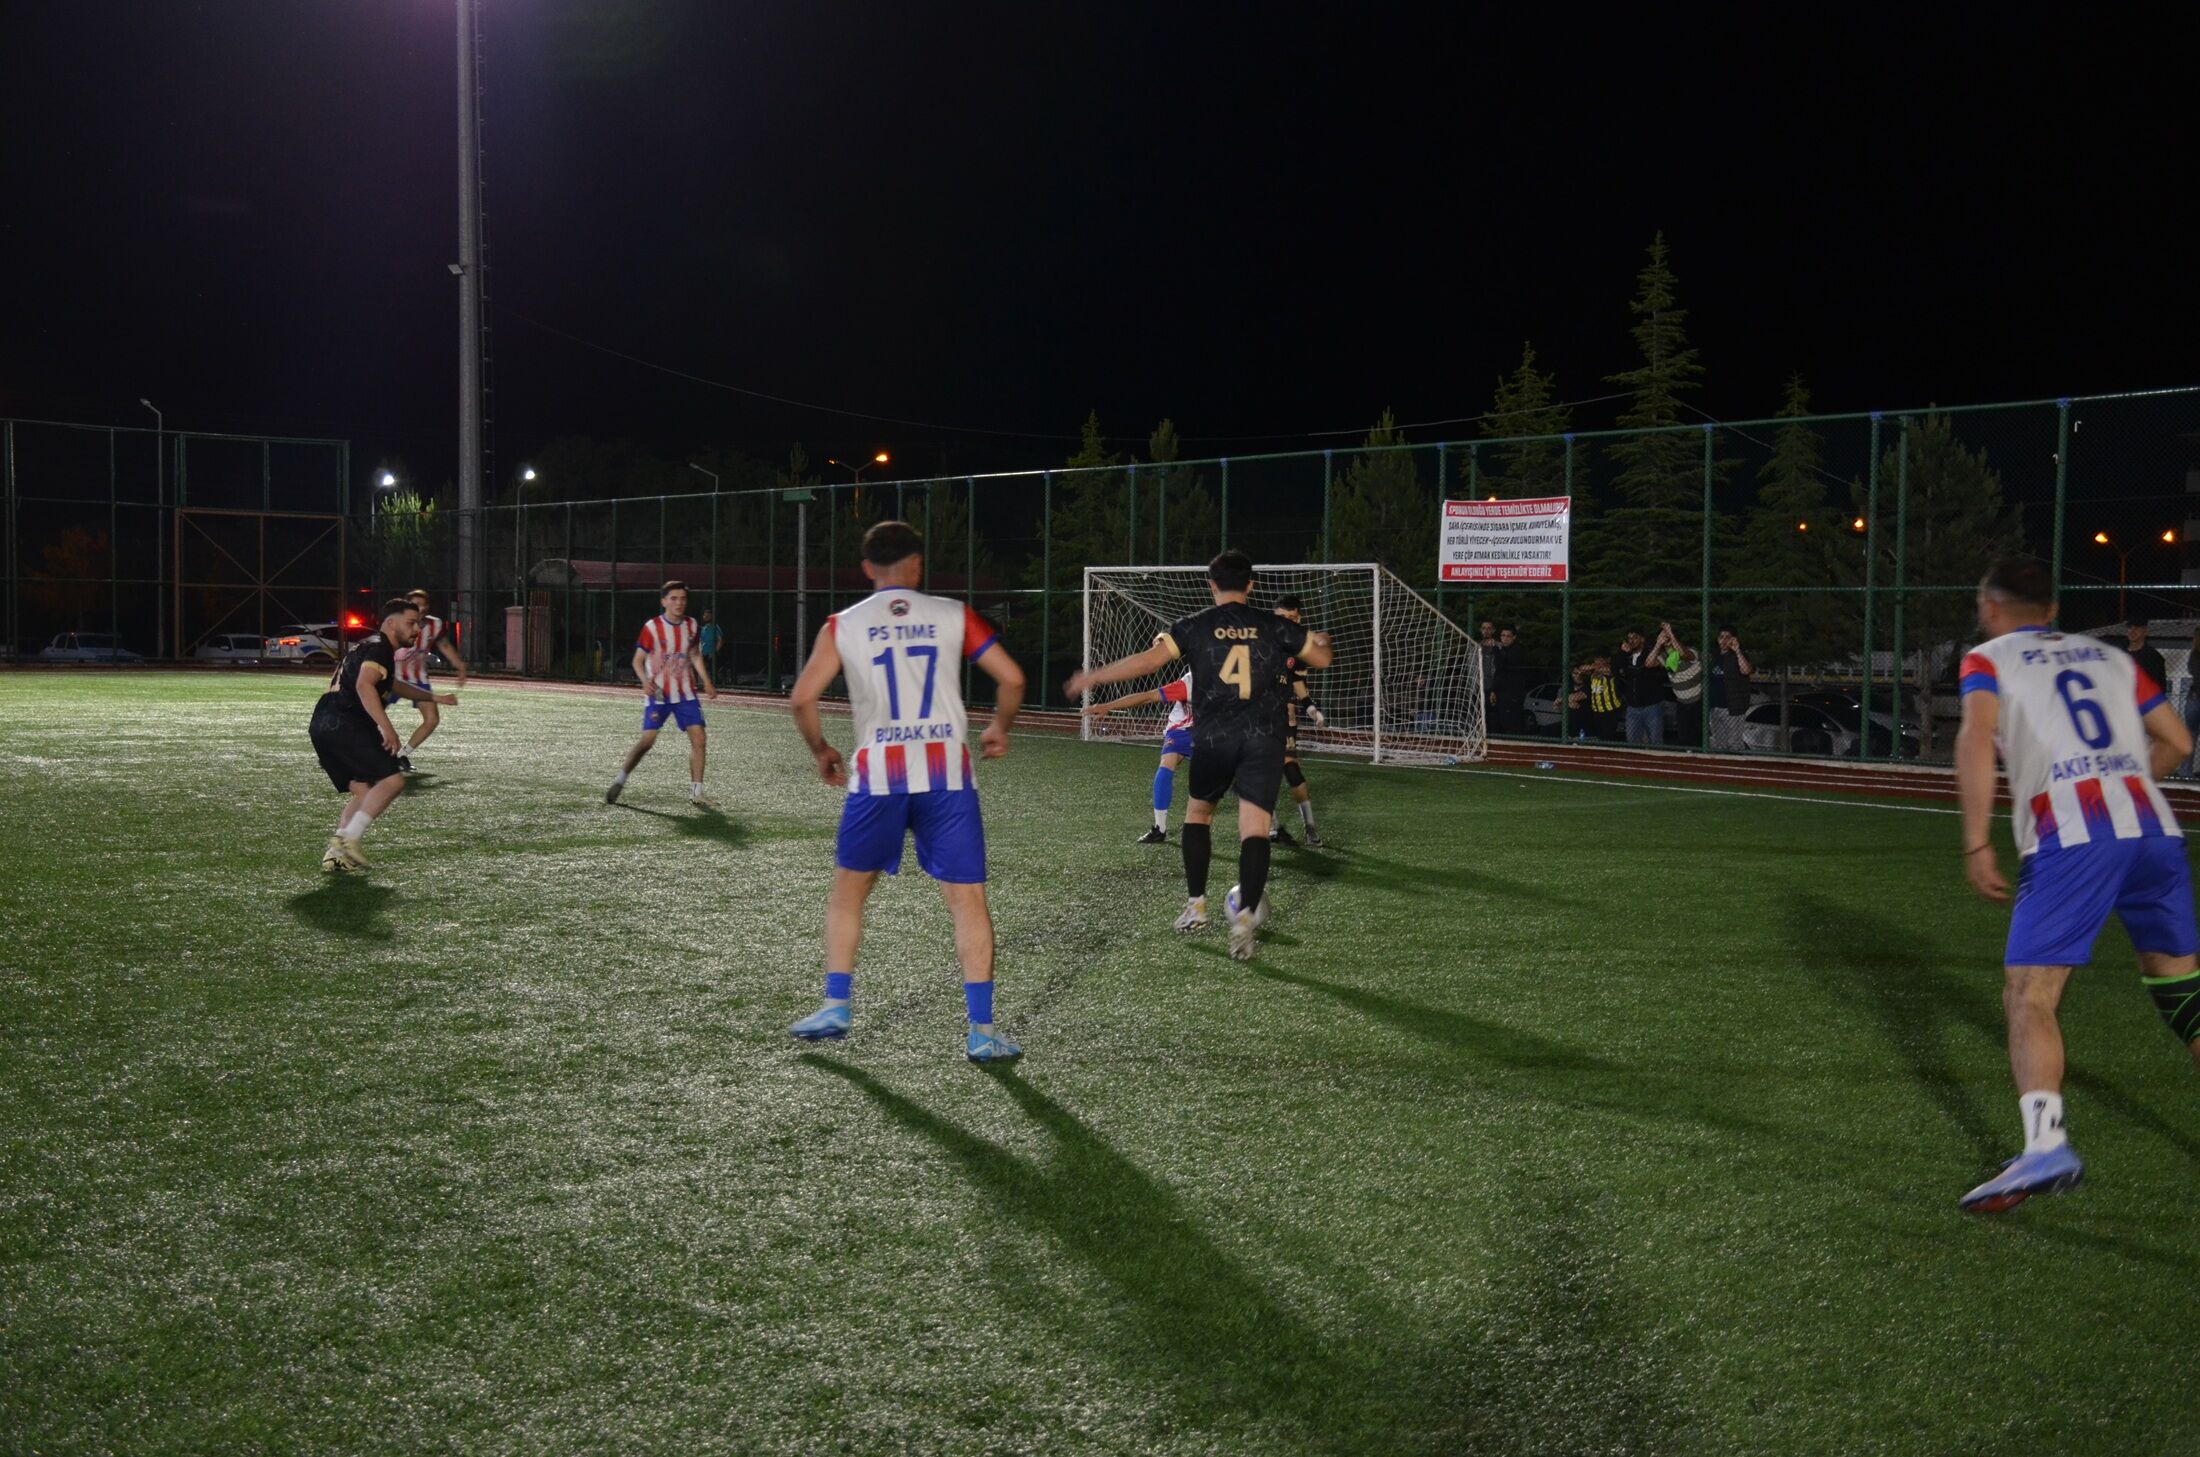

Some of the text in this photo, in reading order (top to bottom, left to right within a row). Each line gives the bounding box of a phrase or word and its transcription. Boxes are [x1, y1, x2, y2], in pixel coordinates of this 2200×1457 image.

[1501, 504, 1533, 515] TEMİZLİKTE
[1460, 521, 1489, 532] İÇERİSİNDE
[1490, 521, 1509, 531] SİGARA
[1555, 535, 1562, 544] VE
[1464, 550, 1473, 561] ÇÖP
[1474, 551, 1491, 560] ATMAK
[1491, 550, 1520, 560] KESİNLİKLE
[1522, 551, 1551, 560] YASAKTIR!
[1451, 566, 1552, 578] ANLAYIŞINIZ İÇİN TEŞEKKÜR EDERİZ
[868, 624, 937, 641] PS TIME
[1214, 626, 1258, 639] OĞUZ
[2022, 649, 2048, 665] PS
[1219, 645, 1252, 700] 4
[873, 645, 938, 720] 17
[2055, 669, 2112, 750] 6
[875, 723, 953, 743] BURAK KIR
